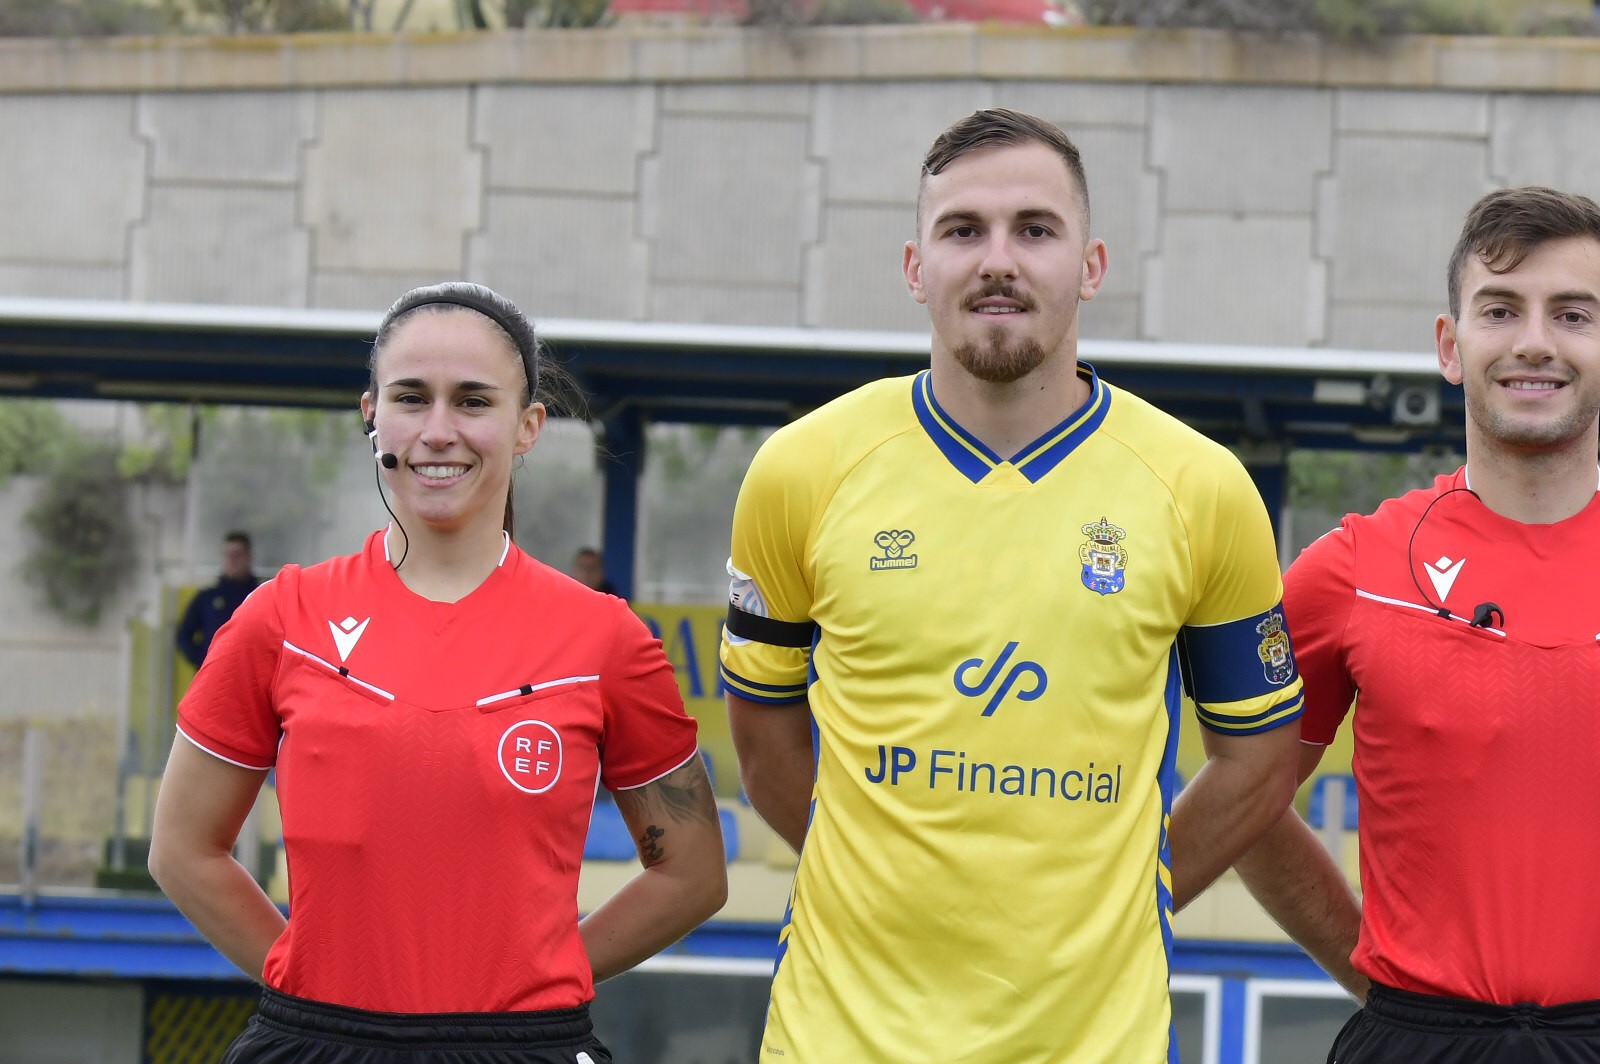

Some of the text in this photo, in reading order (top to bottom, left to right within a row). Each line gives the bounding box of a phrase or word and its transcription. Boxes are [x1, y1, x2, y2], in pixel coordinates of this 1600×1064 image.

[871, 555, 917, 570] hummel
[864, 744, 1122, 803] JP Financial
